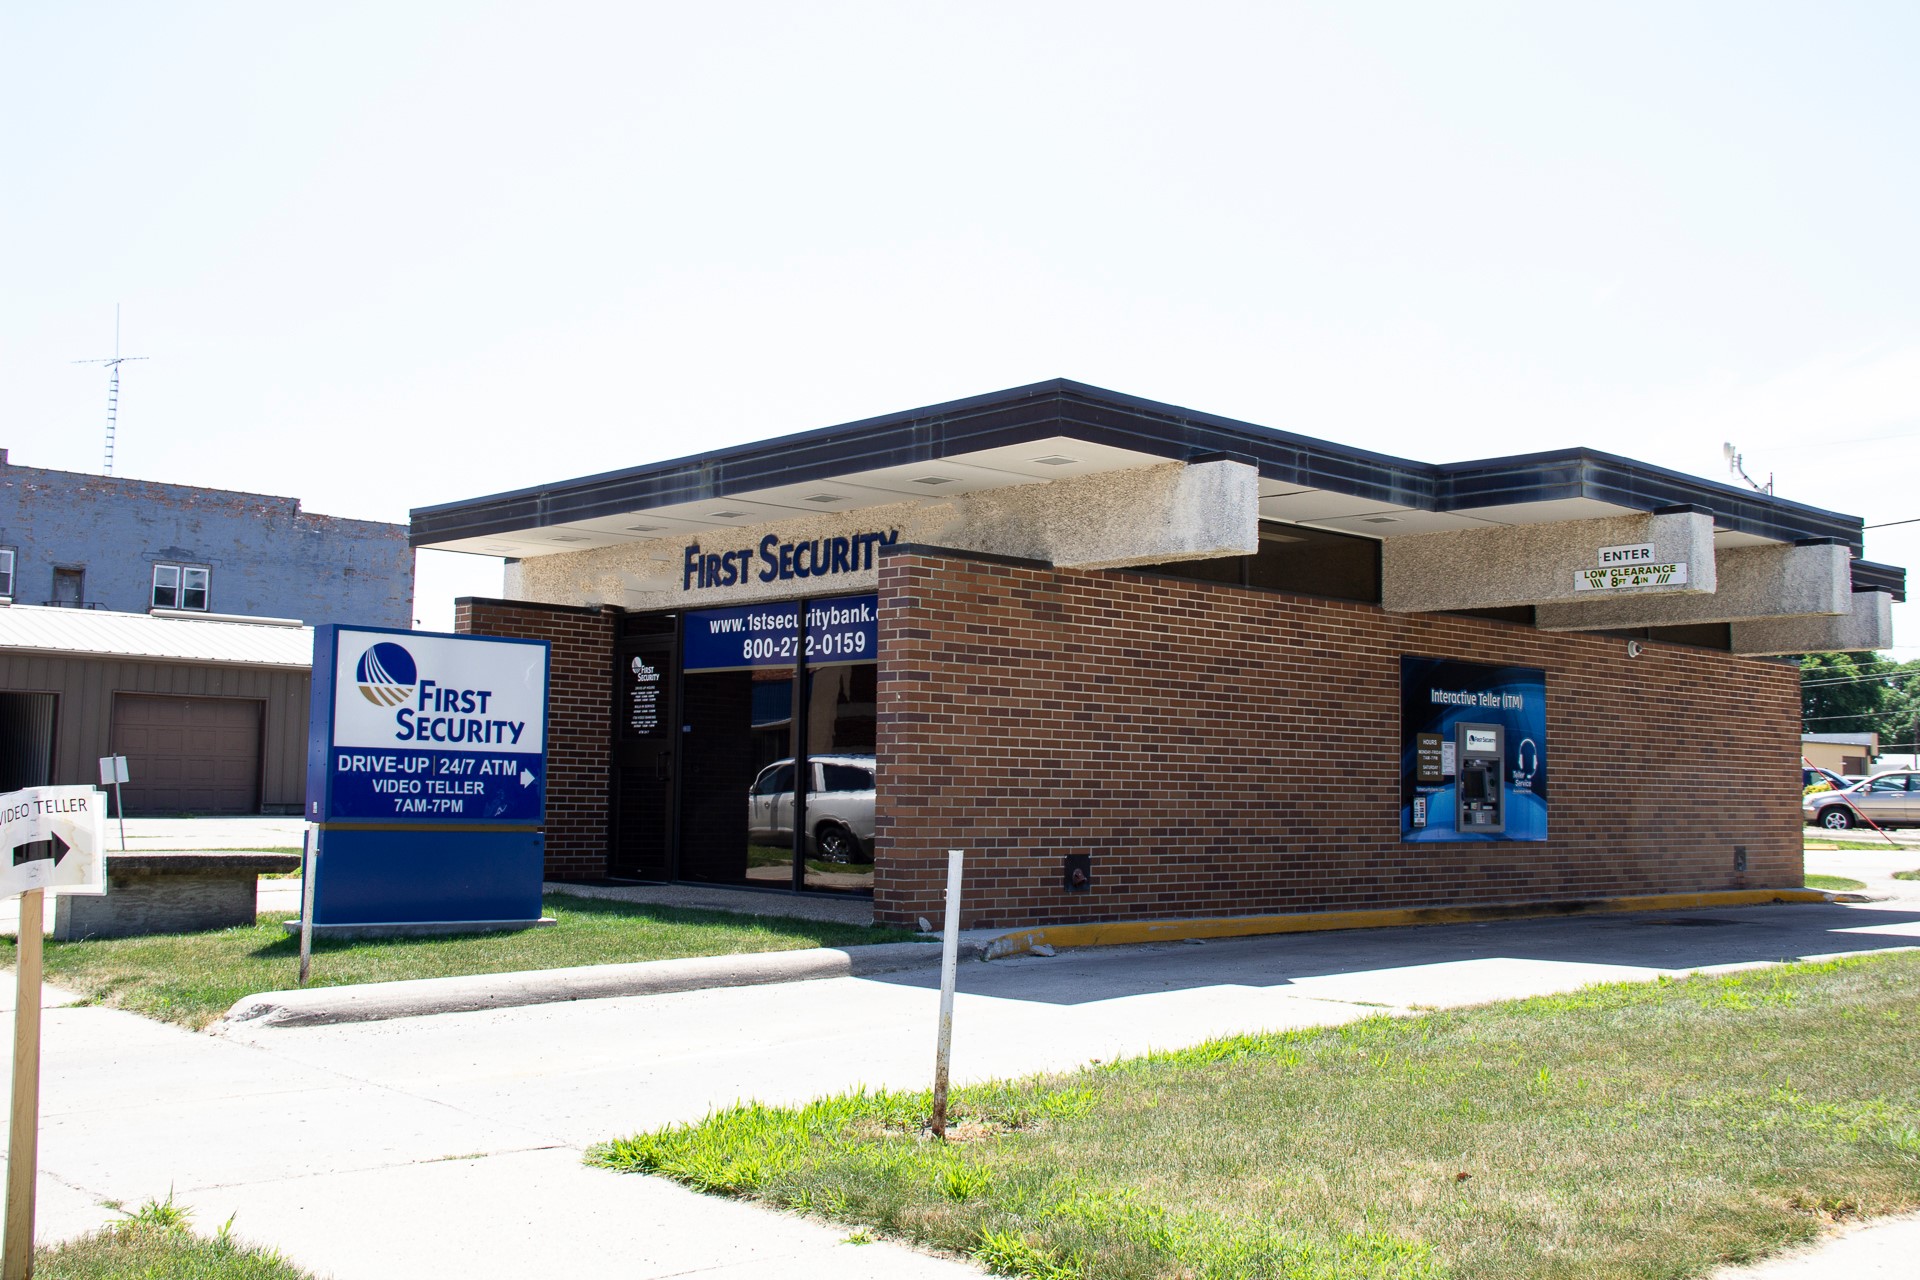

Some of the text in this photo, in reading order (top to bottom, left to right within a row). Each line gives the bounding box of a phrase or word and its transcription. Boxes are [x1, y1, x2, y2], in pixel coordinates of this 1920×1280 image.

[1603, 548, 1650, 562] ENTER
[683, 545, 753, 591] FIRST
[1584, 564, 1677, 579] LOW CLEARANCE
[710, 603, 879, 634] www.1stsecuritybank.
[743, 631, 866, 659] 800-272-0159
[418, 679, 492, 714] FIRST
[1431, 689, 1477, 706] Interactive
[1478, 693, 1500, 707] Teller
[395, 707, 525, 744] SECURITY
[338, 755, 517, 776] DRIVE-UP 24/7 ATM
[372, 779, 485, 795] VIDEO TELLER
[33, 798, 88, 814] TELLER
[394, 799, 463, 813] 7AM-7PM
